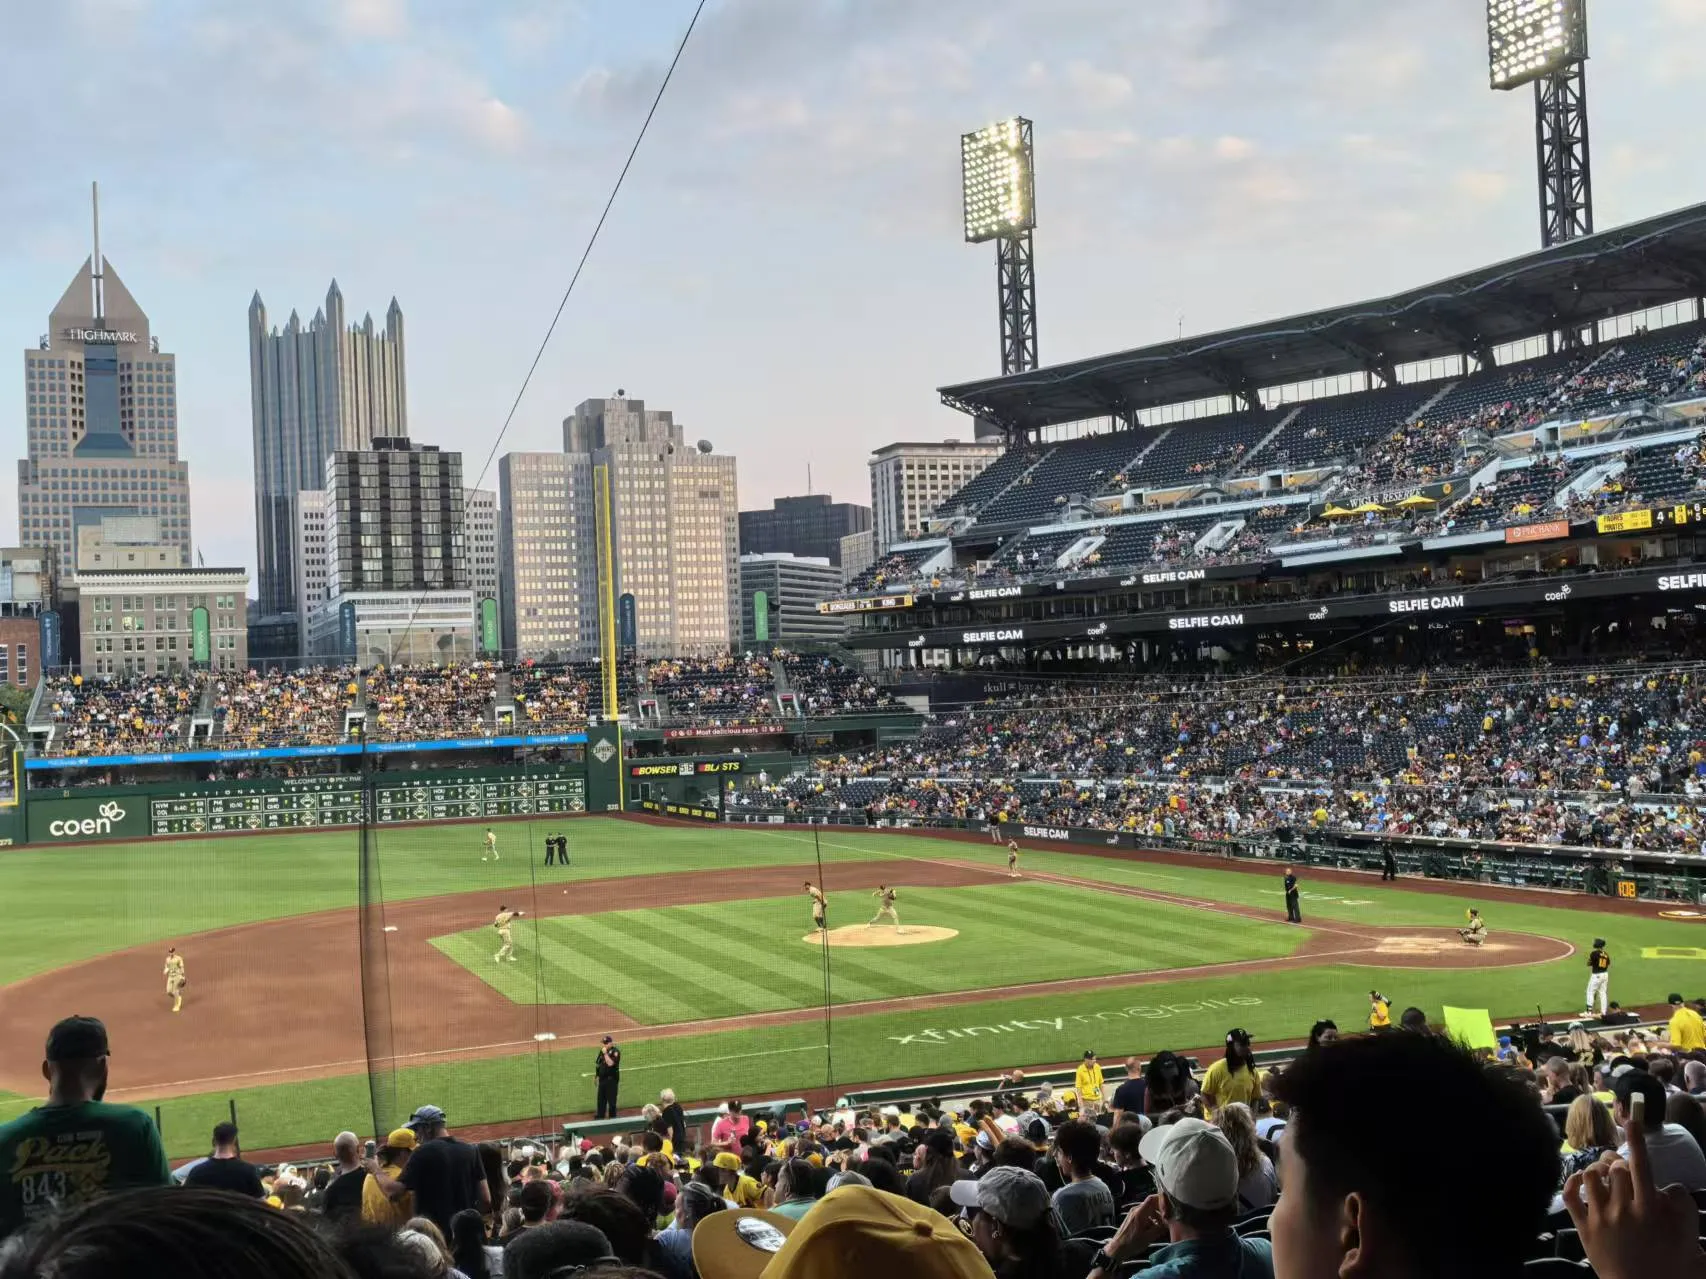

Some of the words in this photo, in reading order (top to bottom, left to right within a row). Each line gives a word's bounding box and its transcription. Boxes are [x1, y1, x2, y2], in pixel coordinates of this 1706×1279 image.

[70, 328, 137, 343] HIGHMARK
[1657, 512, 1664, 520] 4
[1142, 572, 1176, 584] SELFIE
[1177, 570, 1205, 581] CAM
[969, 589, 996, 599] SELFIE
[998, 587, 1021, 597] CAM
[1546, 591, 1566, 601] coen
[1389, 598, 1430, 613] SELFIE
[1431, 595, 1464, 609] CAM
[1169, 617, 1210, 629] SELFIE
[1211, 614, 1243, 626] CAM
[963, 630, 995, 644] SELFIE
[997, 629, 1023, 640] CAM
[639, 765, 677, 774] BOWSER
[284, 777, 317, 785] WELCOME
[50, 818, 111, 836] coen
[1024, 826, 1048, 837] SELFIE
[1048, 828, 1069, 839] CAM
[891, 1017, 1063, 1045] xfinity
[22, 1170, 66, 1204] 843
